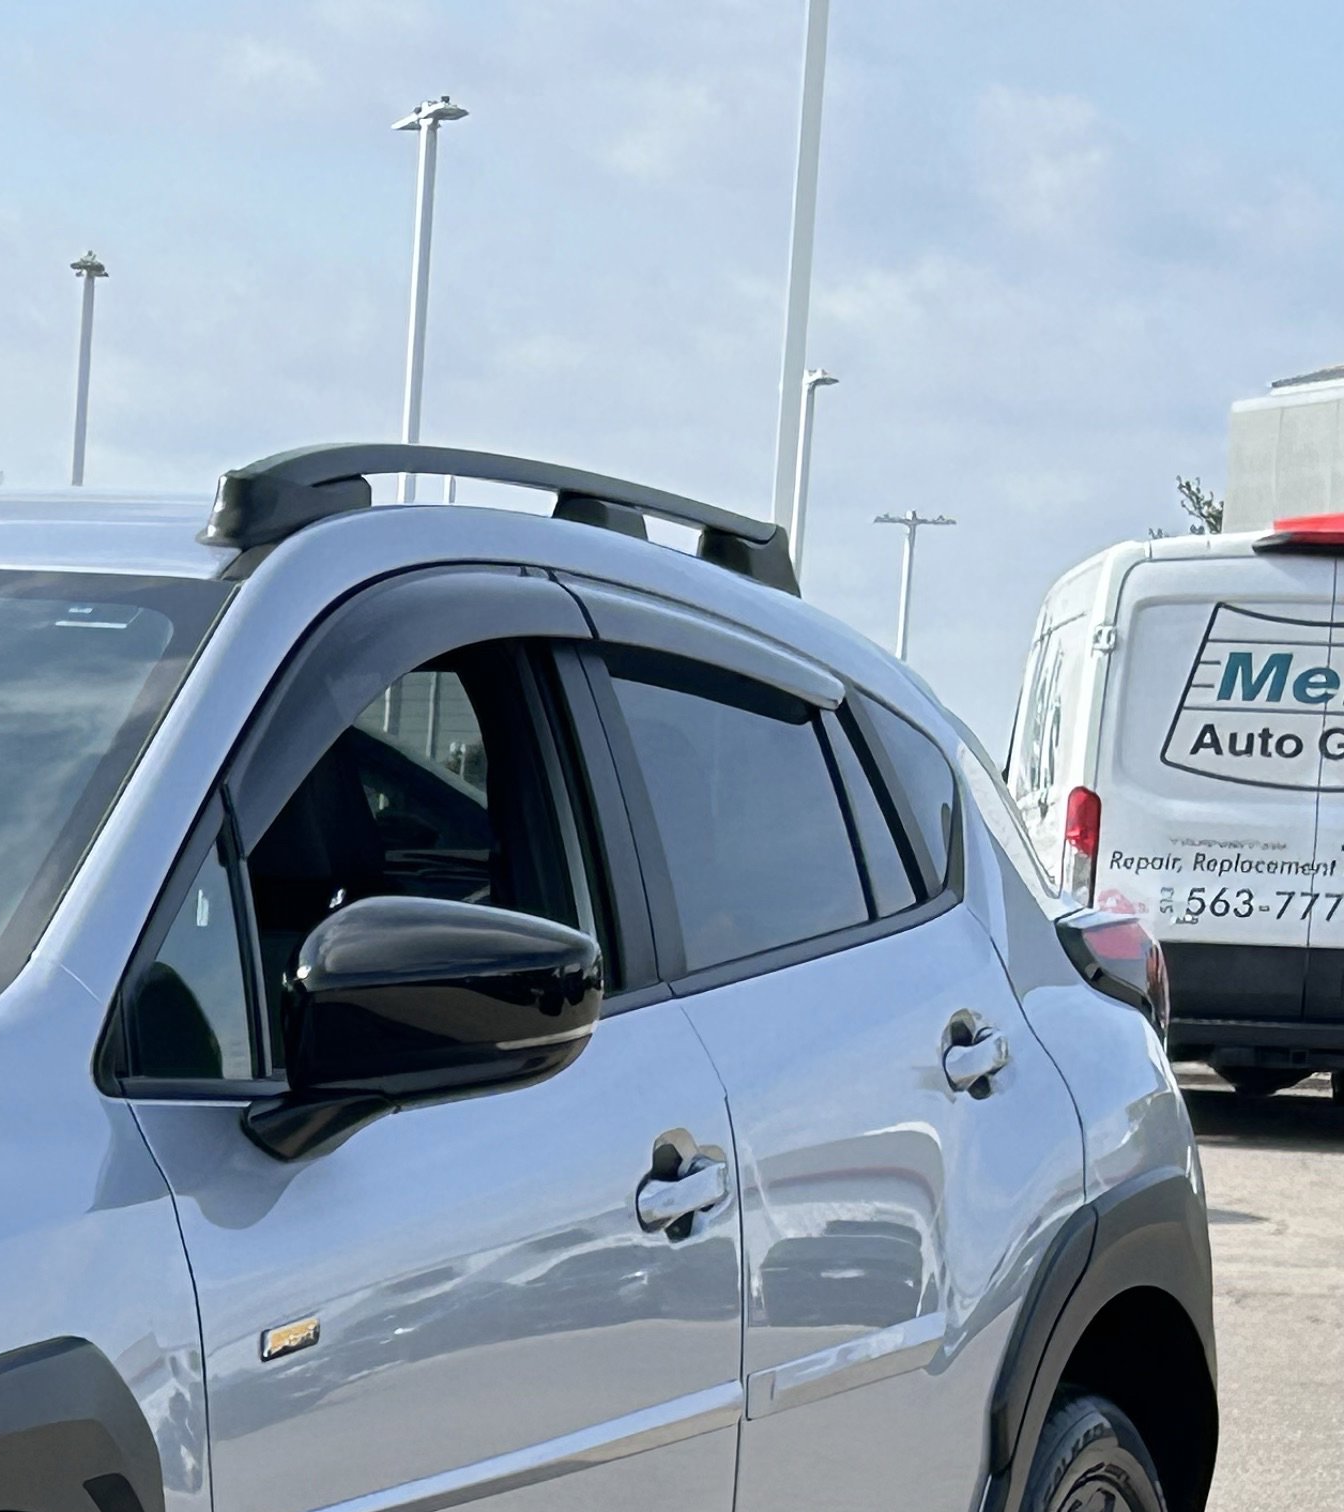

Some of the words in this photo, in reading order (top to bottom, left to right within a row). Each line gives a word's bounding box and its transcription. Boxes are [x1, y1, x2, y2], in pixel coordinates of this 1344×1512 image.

[1216, 652, 1344, 704] Me
[1189, 724, 1303, 758] Auto
[1110, 850, 1183, 874] Repair,
[1193, 852, 1337, 877] Replacement
